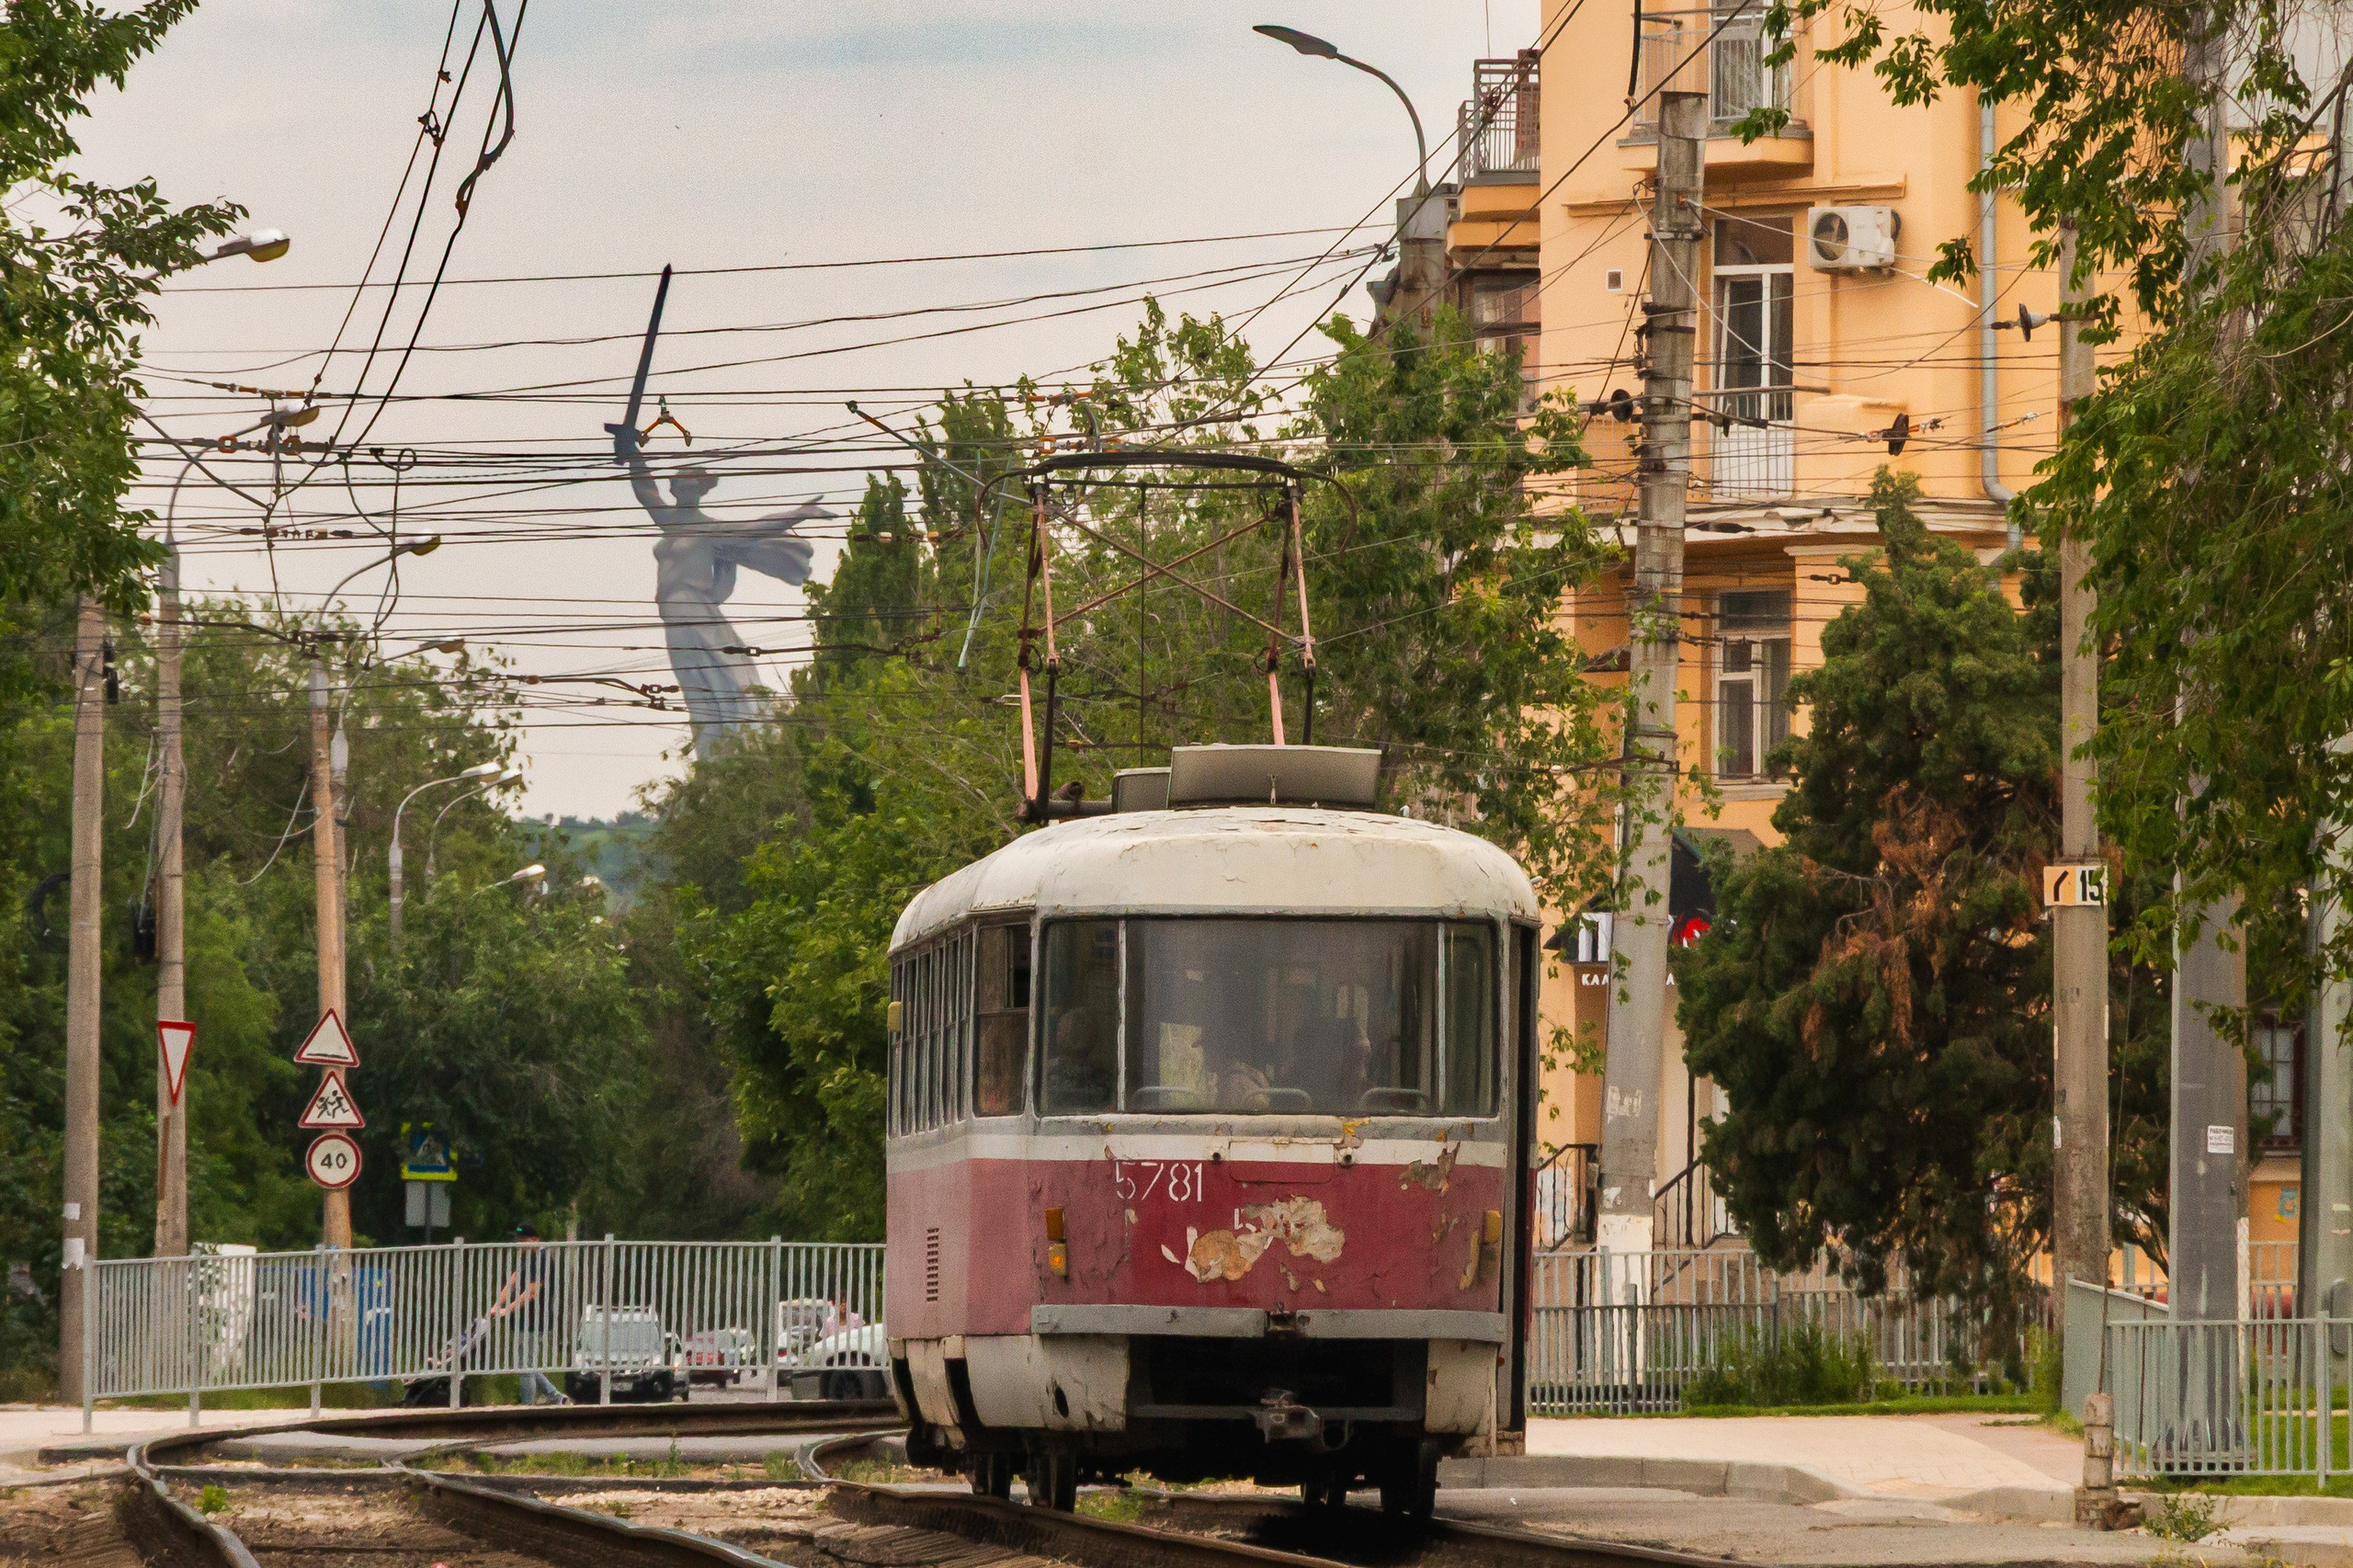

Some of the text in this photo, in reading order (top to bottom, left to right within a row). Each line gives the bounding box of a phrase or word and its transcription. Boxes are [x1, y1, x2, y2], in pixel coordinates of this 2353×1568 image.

[2080, 869, 2104, 902] 15
[320, 1153, 347, 1169] 40
[1115, 1161, 1203, 1202] 5781
